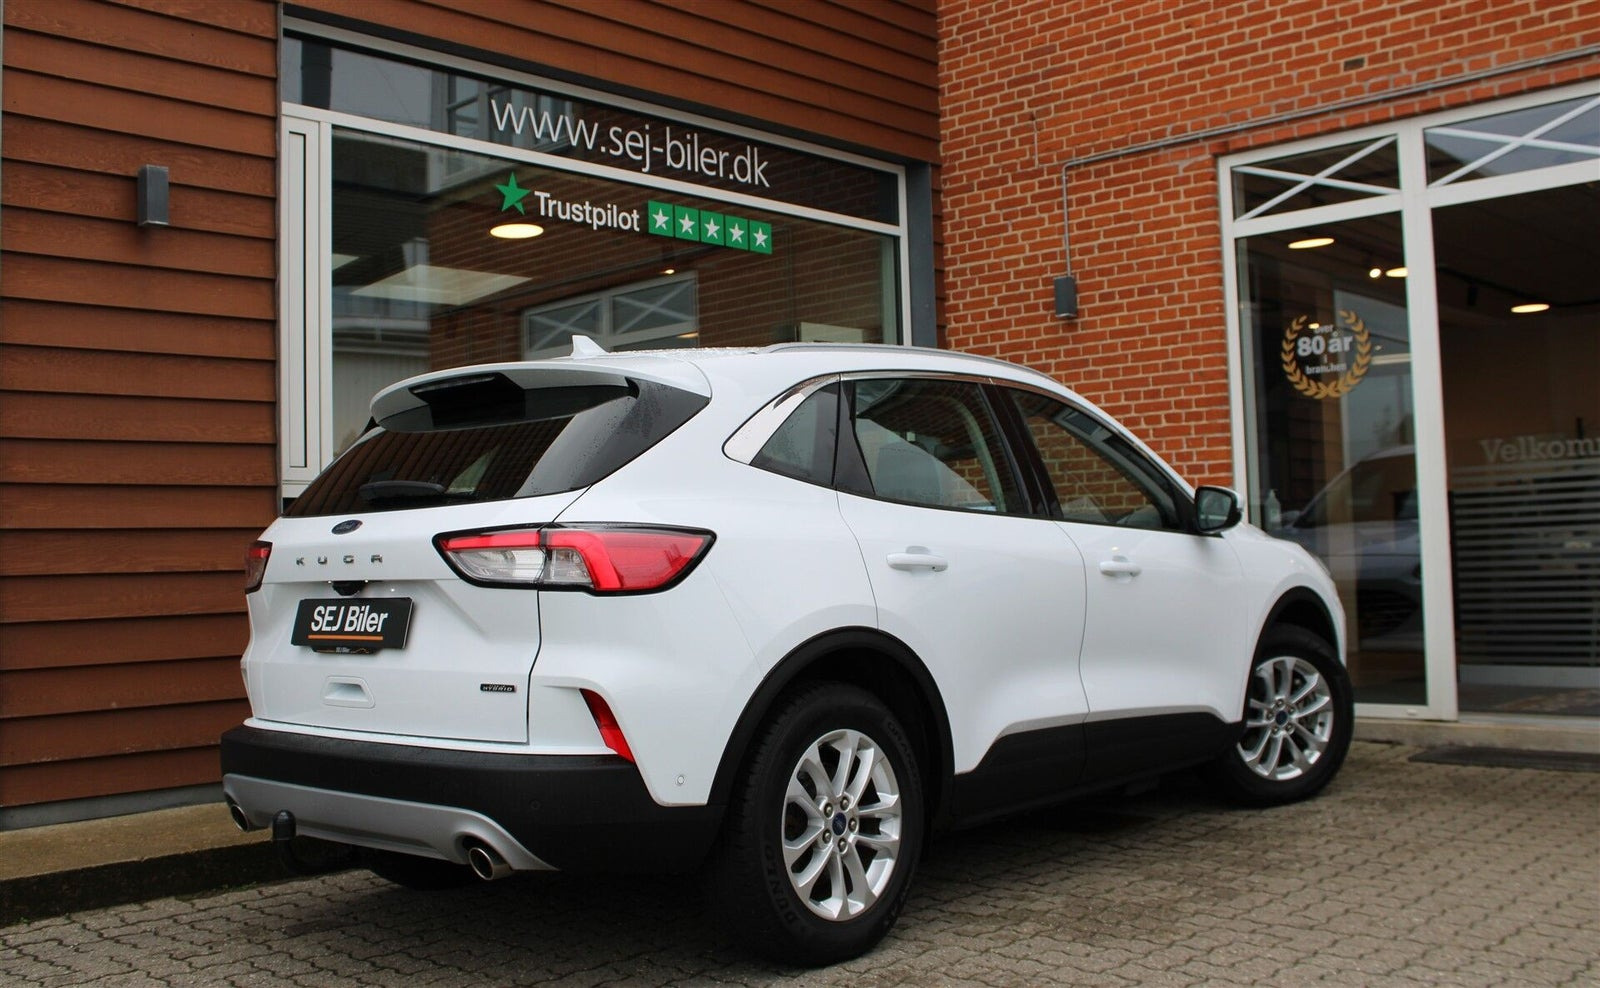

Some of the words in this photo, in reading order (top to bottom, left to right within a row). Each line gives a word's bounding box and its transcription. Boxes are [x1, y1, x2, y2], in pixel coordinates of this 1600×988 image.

[491, 99, 770, 188] www.sej-biler.dk
[534, 190, 641, 232] Trustpilot
[1297, 335, 1325, 356] 80
[1328, 331, 1353, 353] år
[1480, 436, 1600, 462] Velkom
[296, 554, 383, 566] KUGA
[311, 605, 345, 632] SEJ
[344, 605, 388, 632] Biler
